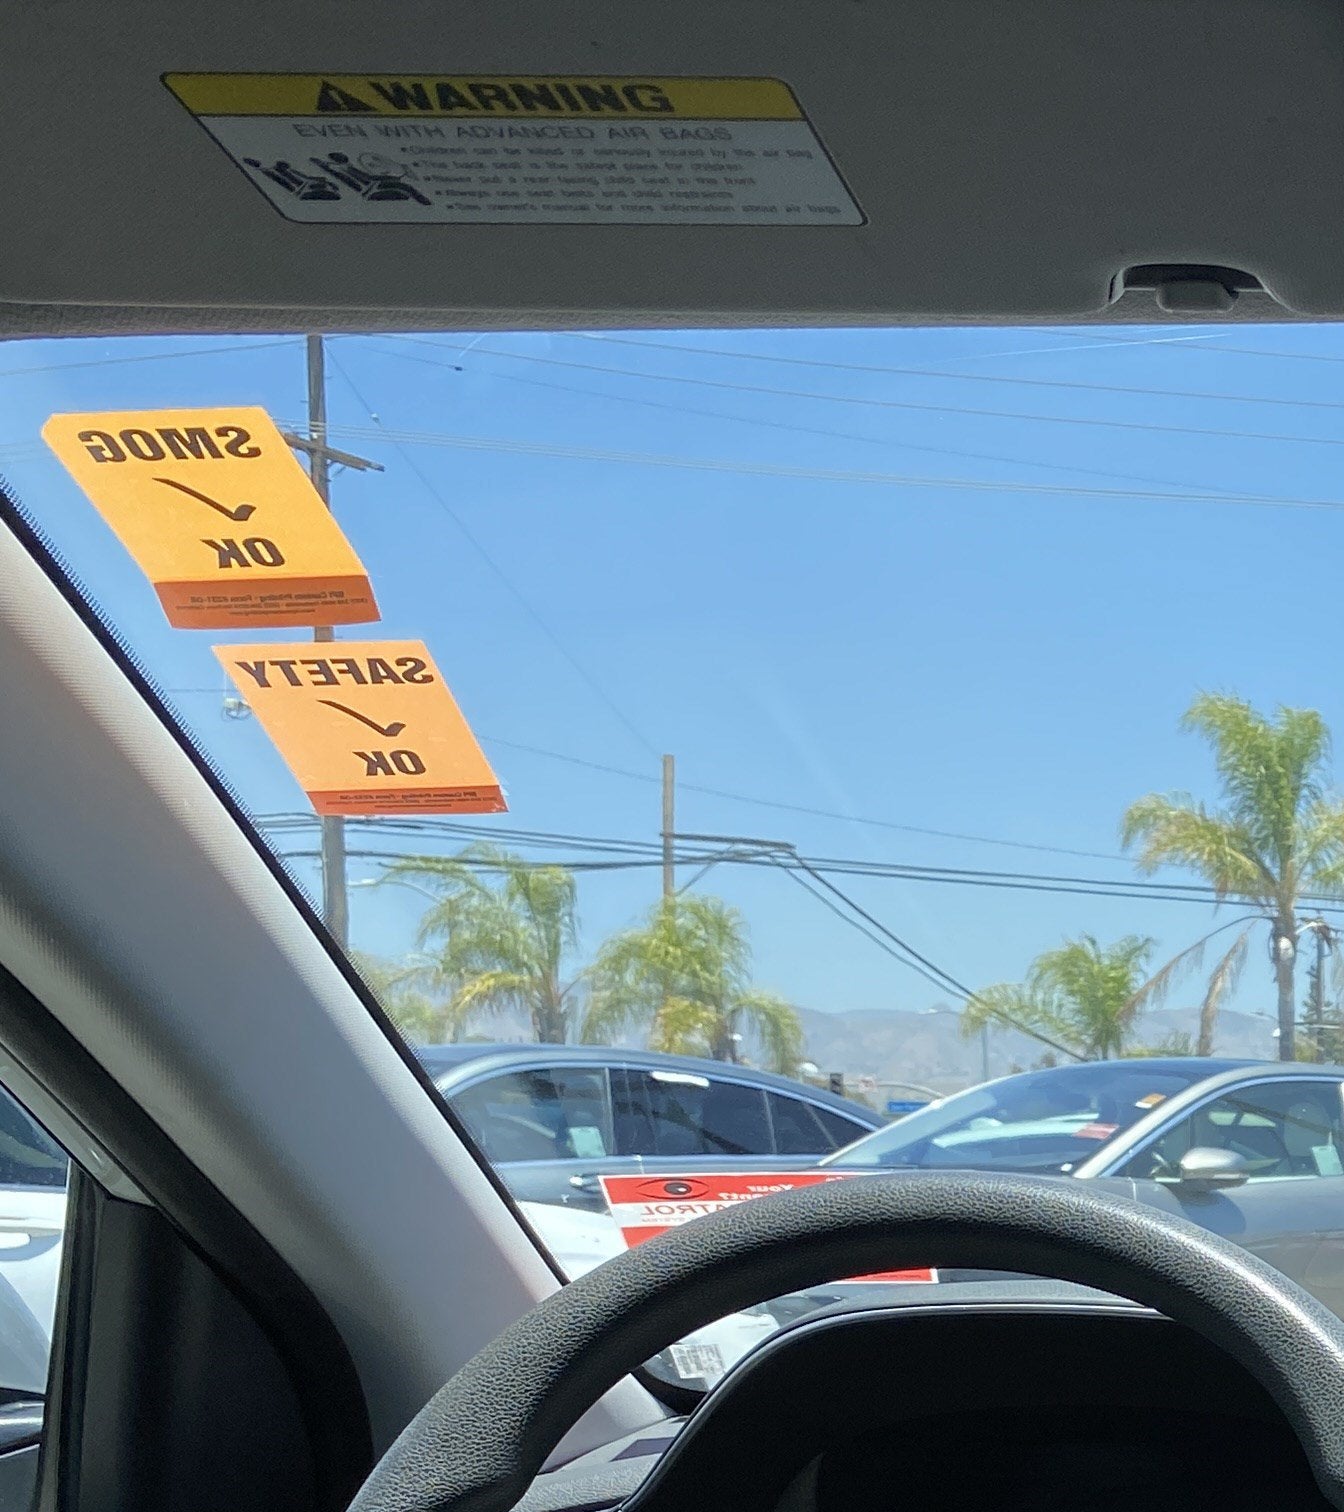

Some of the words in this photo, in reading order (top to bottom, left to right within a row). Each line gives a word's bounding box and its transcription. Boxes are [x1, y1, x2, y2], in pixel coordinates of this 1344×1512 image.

[368, 82, 675, 112] WARNING
[292, 123, 367, 138] EVEN
[377, 124, 446, 139] WITH
[456, 125, 595, 140] ADVANCED
[608, 126, 649, 141] AIR
[659, 126, 734, 142] BAGS
